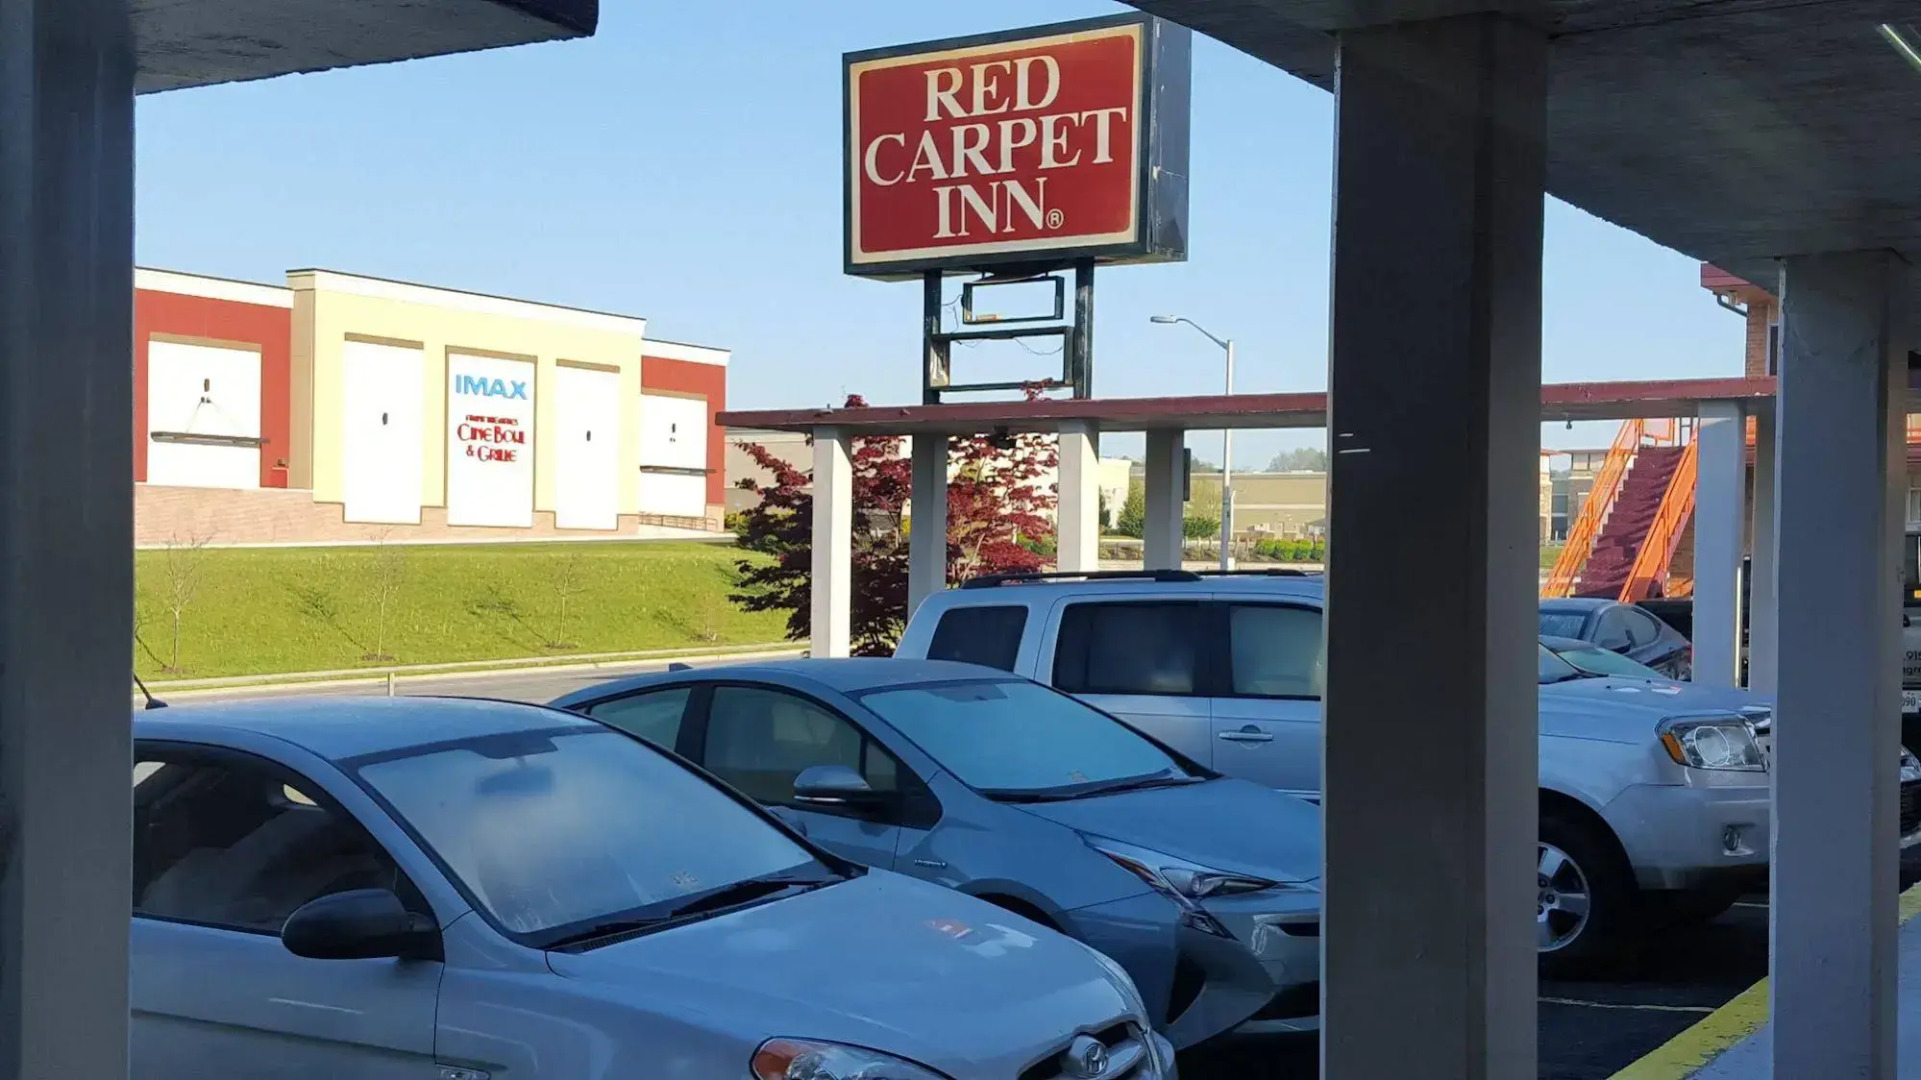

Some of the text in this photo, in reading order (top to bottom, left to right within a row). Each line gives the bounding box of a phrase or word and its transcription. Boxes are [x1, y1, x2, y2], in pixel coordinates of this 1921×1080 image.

[923, 55, 1061, 122] RED
[864, 107, 1128, 186] CARPET
[455, 374, 528, 400] IMAX
[466, 445, 474, 457] &
